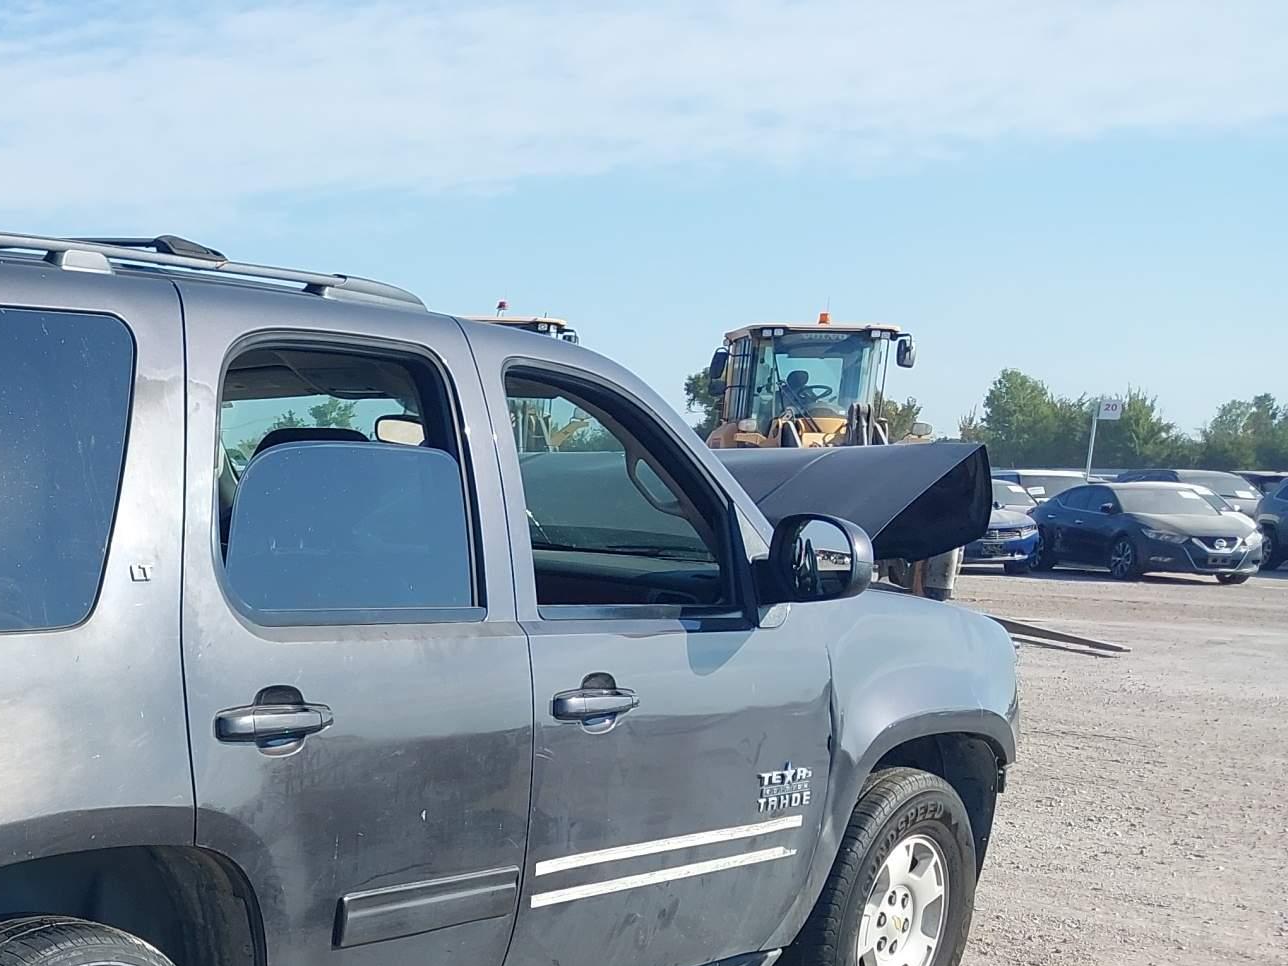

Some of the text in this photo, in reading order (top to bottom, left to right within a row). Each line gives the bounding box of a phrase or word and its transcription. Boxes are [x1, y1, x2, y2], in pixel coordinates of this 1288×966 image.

[1103, 403, 1118, 412] 20
[129, 564, 152, 582] LT
[757, 791, 811, 813] TAHOE
